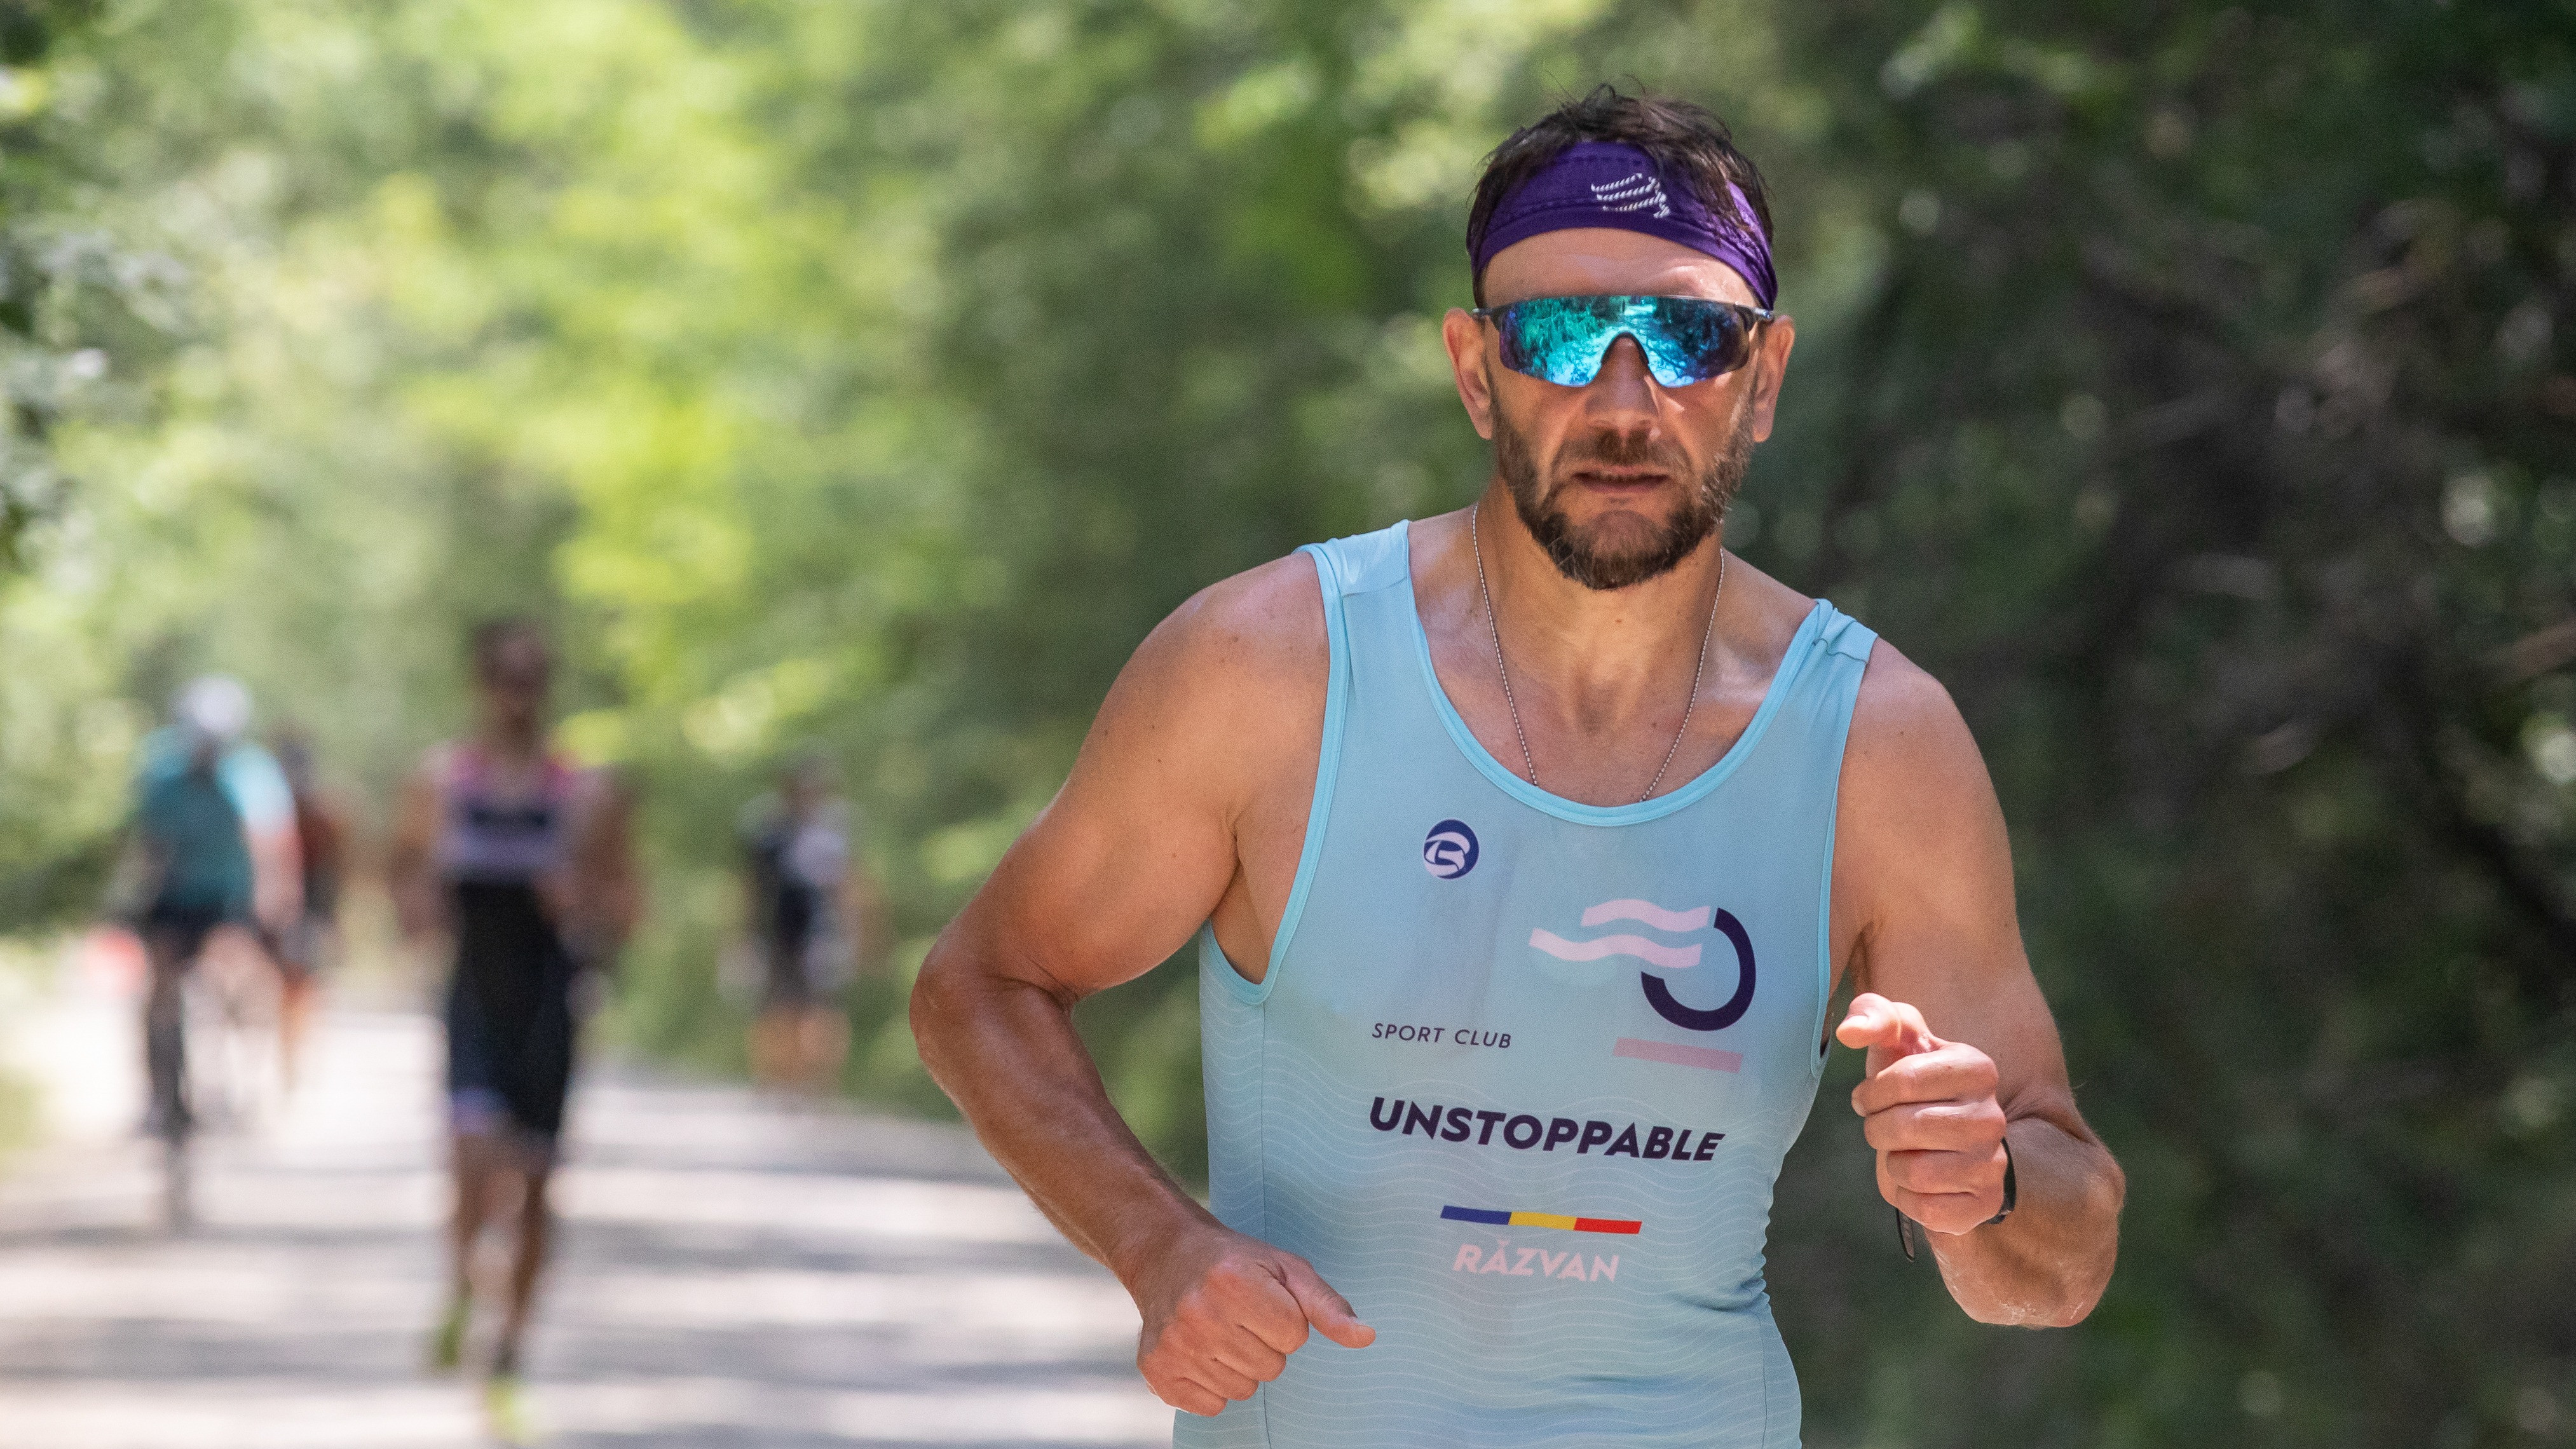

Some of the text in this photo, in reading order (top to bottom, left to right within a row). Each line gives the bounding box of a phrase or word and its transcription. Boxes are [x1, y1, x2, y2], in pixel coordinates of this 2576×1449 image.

[1371, 1022, 1512, 1049] SPORT CLUB
[1369, 1096, 1726, 1161] UNSTOPPABLE
[1453, 1240, 1619, 1282] RĂZVAN
